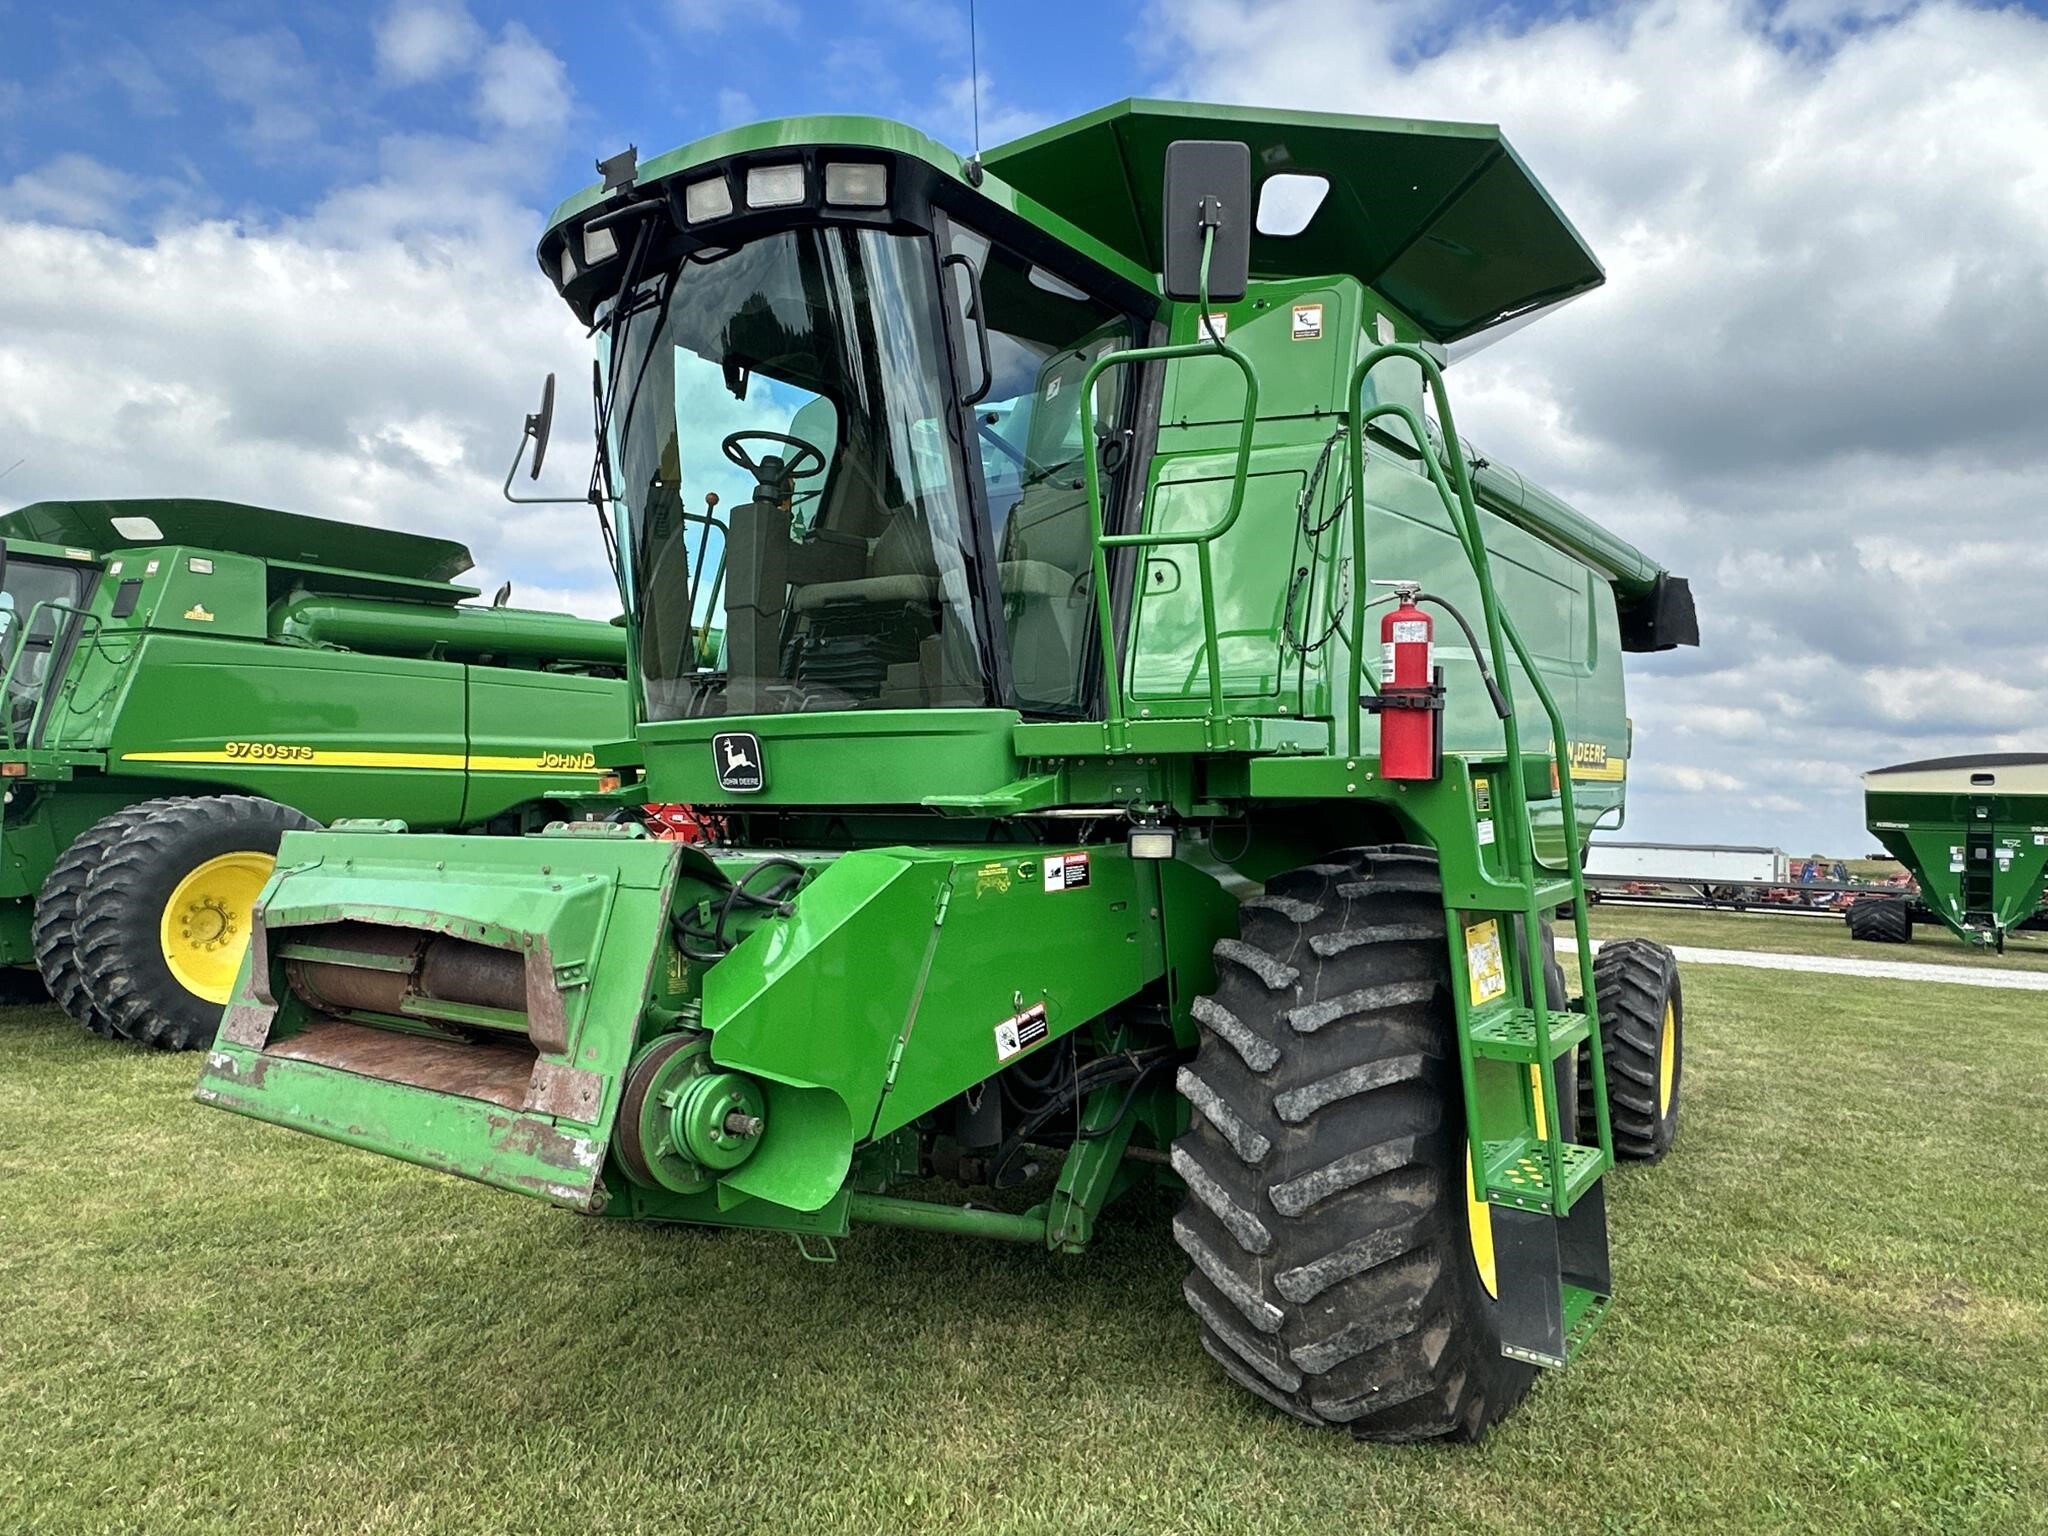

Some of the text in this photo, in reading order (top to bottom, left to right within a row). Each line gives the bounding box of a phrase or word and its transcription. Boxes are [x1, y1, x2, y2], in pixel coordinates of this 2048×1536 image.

[225, 742, 313, 759] 9760STS
[1577, 742, 1607, 763] DEERE
[537, 751, 581, 768] JOHN
[723, 777, 759, 786] JOHN DEERE
